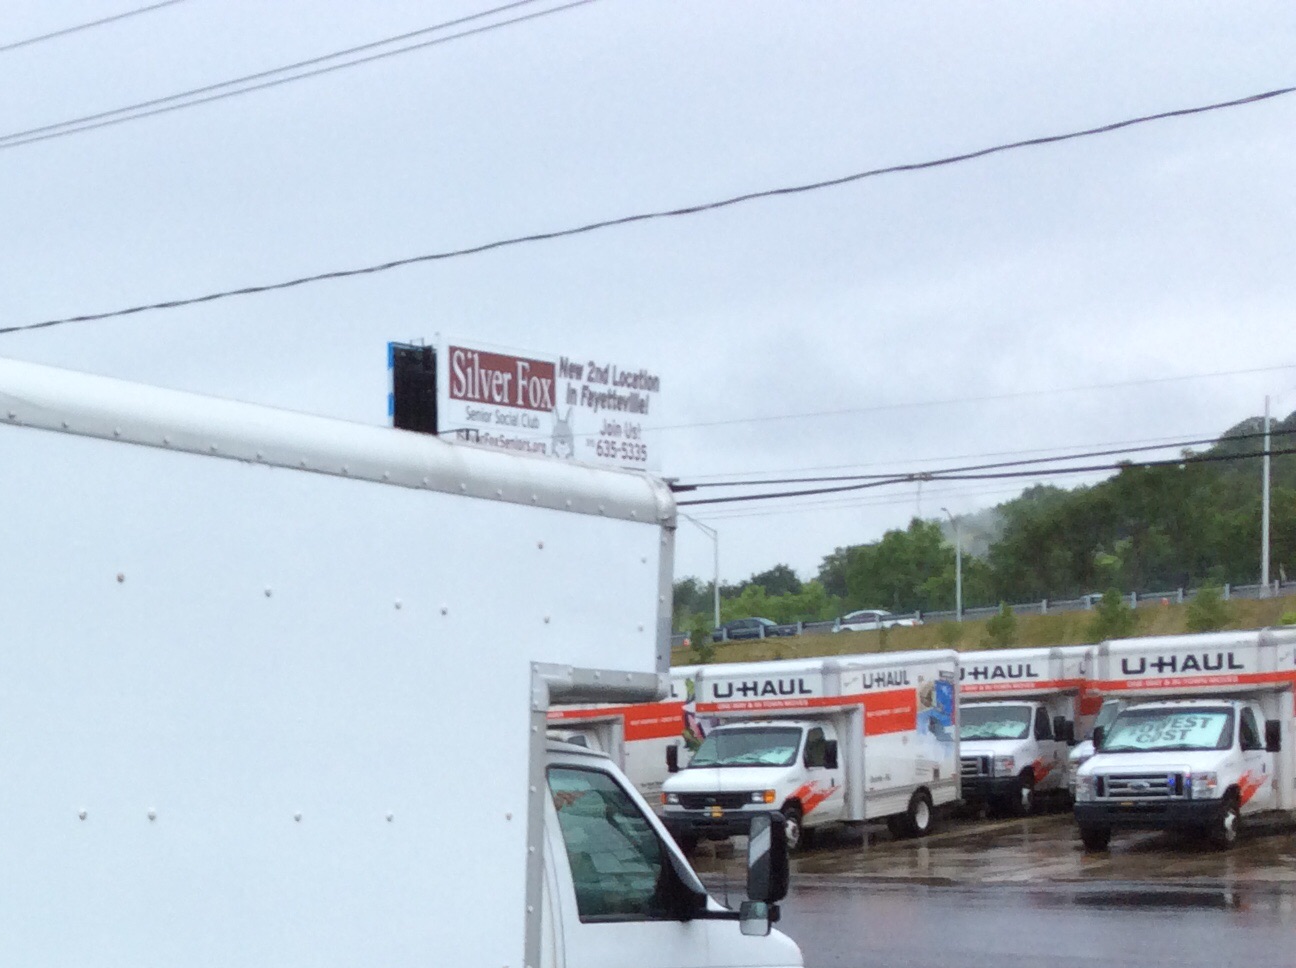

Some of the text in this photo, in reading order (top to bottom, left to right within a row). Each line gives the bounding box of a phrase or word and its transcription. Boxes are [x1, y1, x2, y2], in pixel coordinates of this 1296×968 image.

[452, 349, 553, 409] Silver Fox
[559, 356, 660, 392] New 2nd Location
[466, 405, 540, 429] Senior Social Club
[1121, 652, 1244, 675] U-HAUL
[713, 678, 812, 699] U-HAUL
[862, 670, 910, 689] U-HAUL
